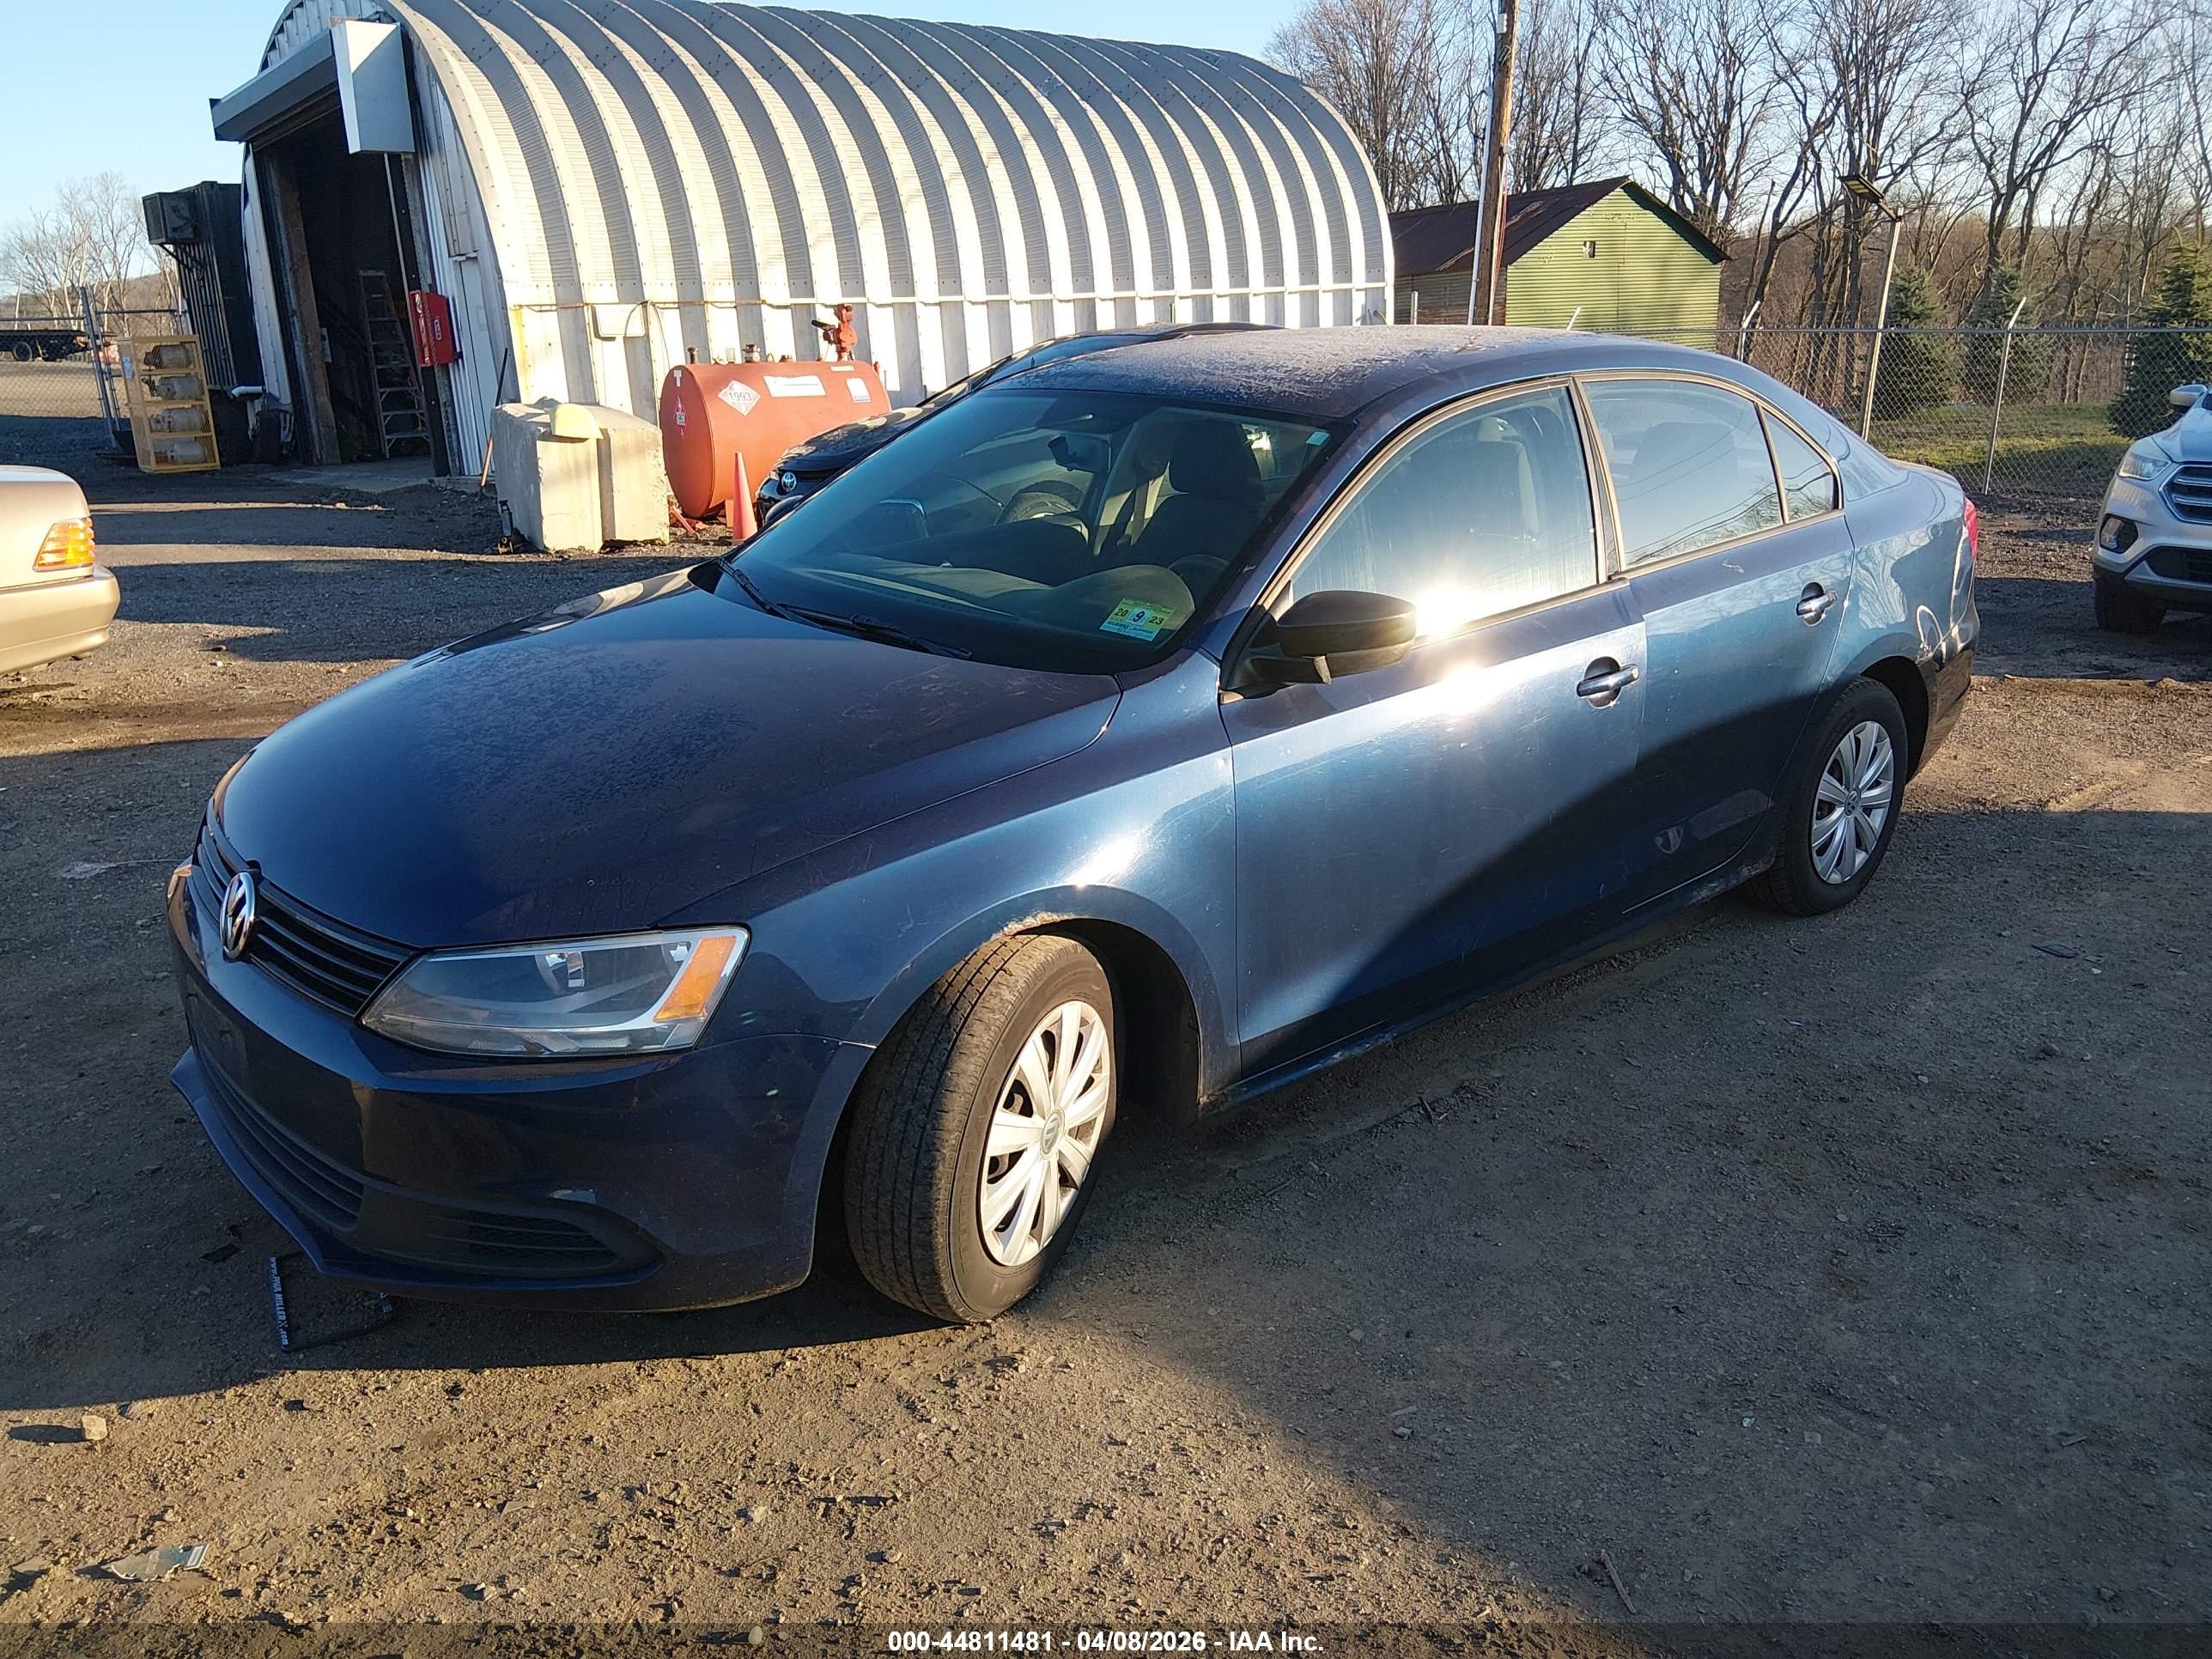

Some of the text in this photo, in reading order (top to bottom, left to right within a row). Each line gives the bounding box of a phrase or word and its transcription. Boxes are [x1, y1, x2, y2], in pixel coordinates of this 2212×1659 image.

[728, 391, 753, 402] 1993
[1115, 608, 1164, 625] 20 9 23
